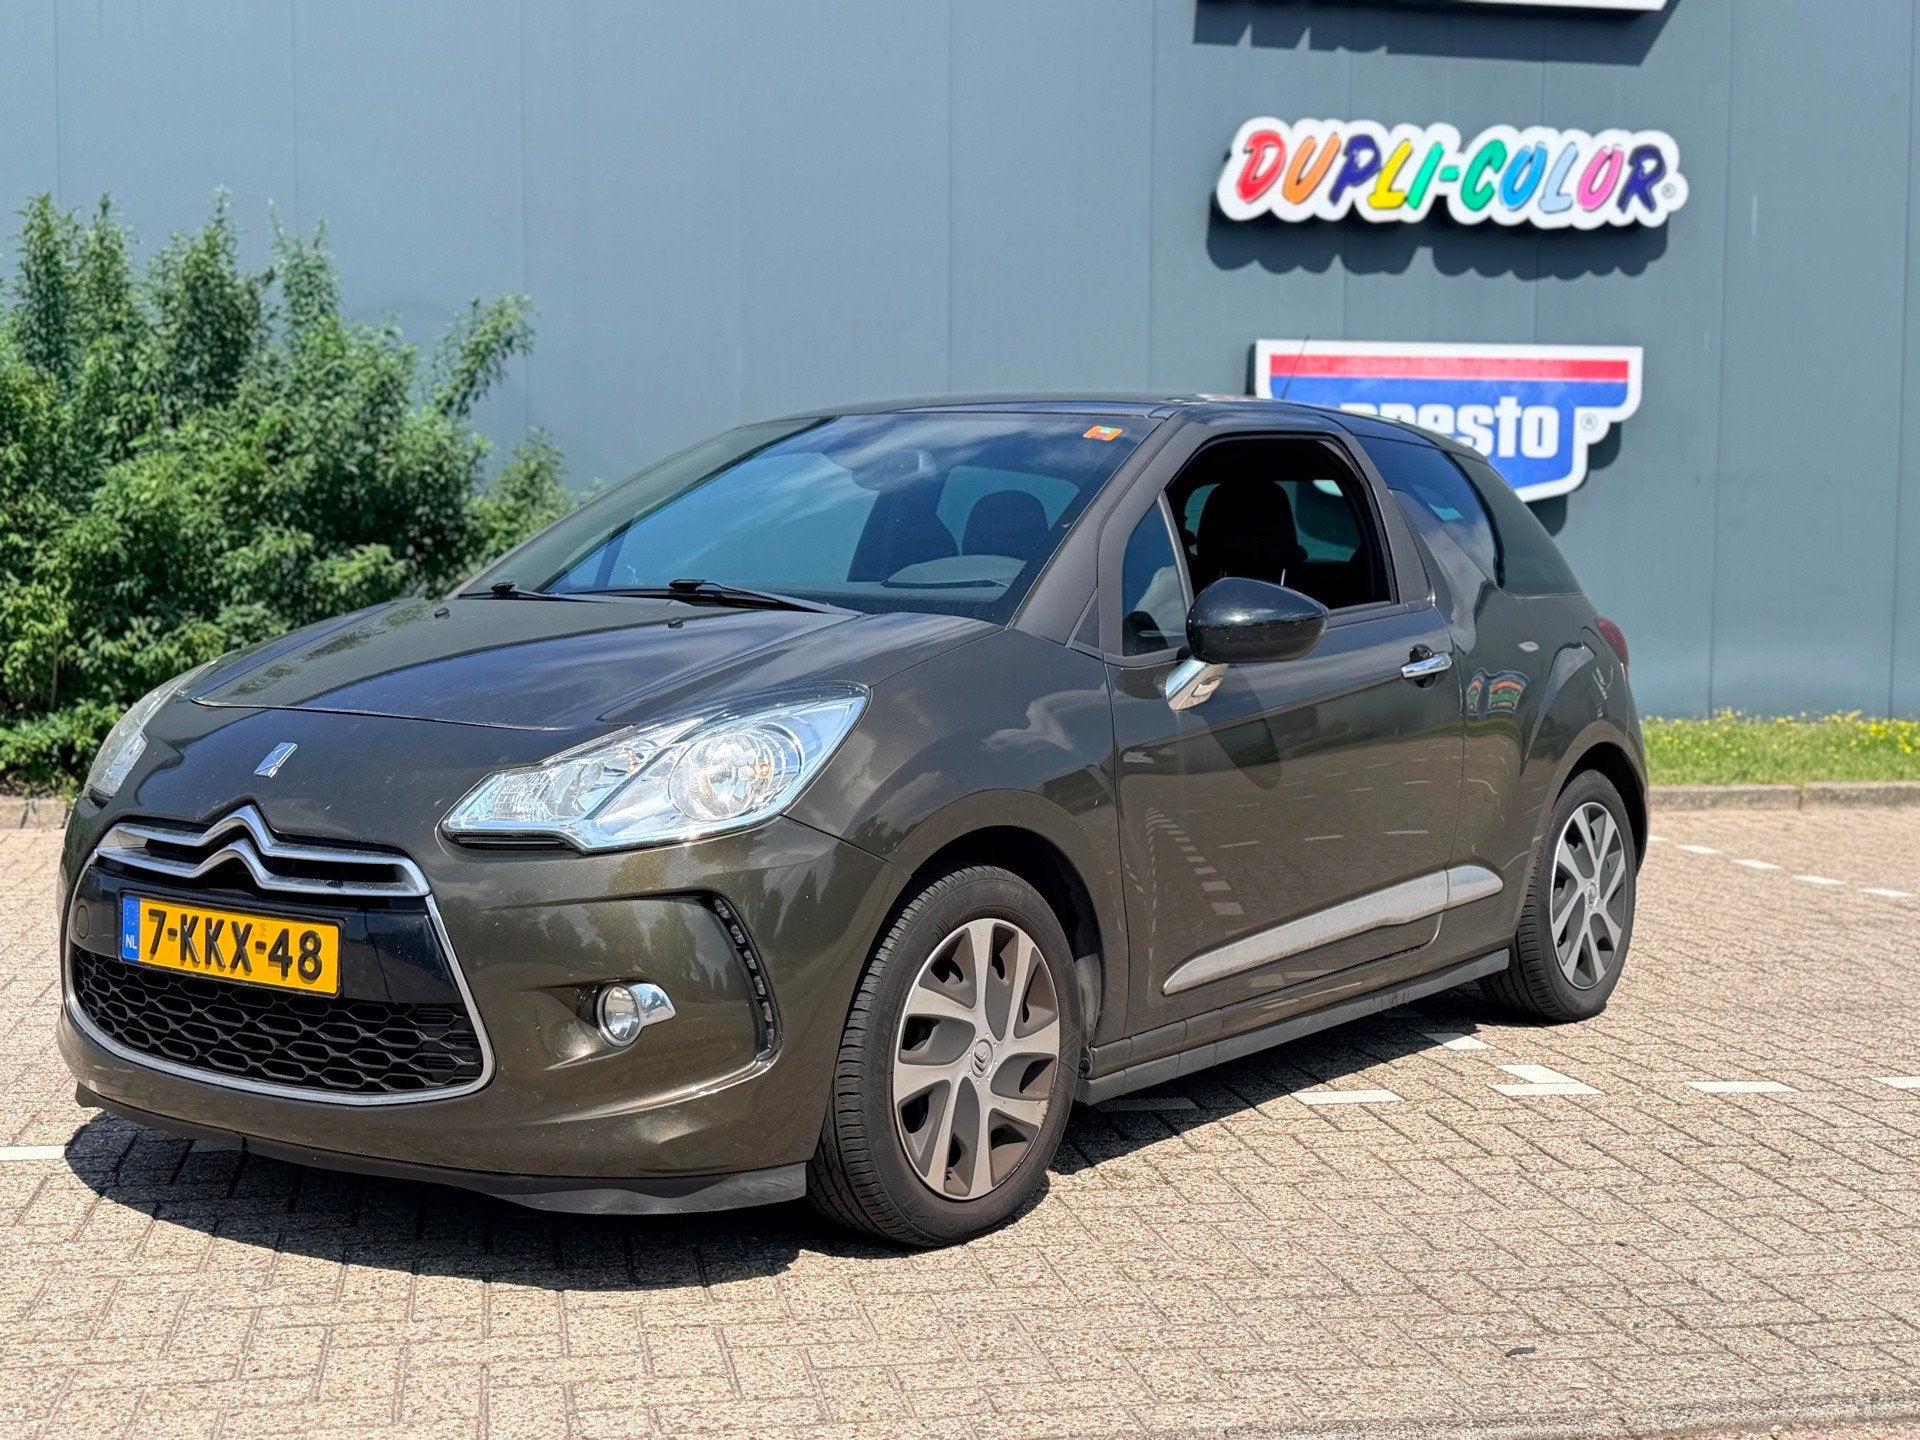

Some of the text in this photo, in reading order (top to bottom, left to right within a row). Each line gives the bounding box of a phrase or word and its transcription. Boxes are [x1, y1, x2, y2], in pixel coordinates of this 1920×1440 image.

[1236, 130, 1667, 214] DUPLI-COLOR
[125, 908, 323, 981] NL 7-KKX-48
